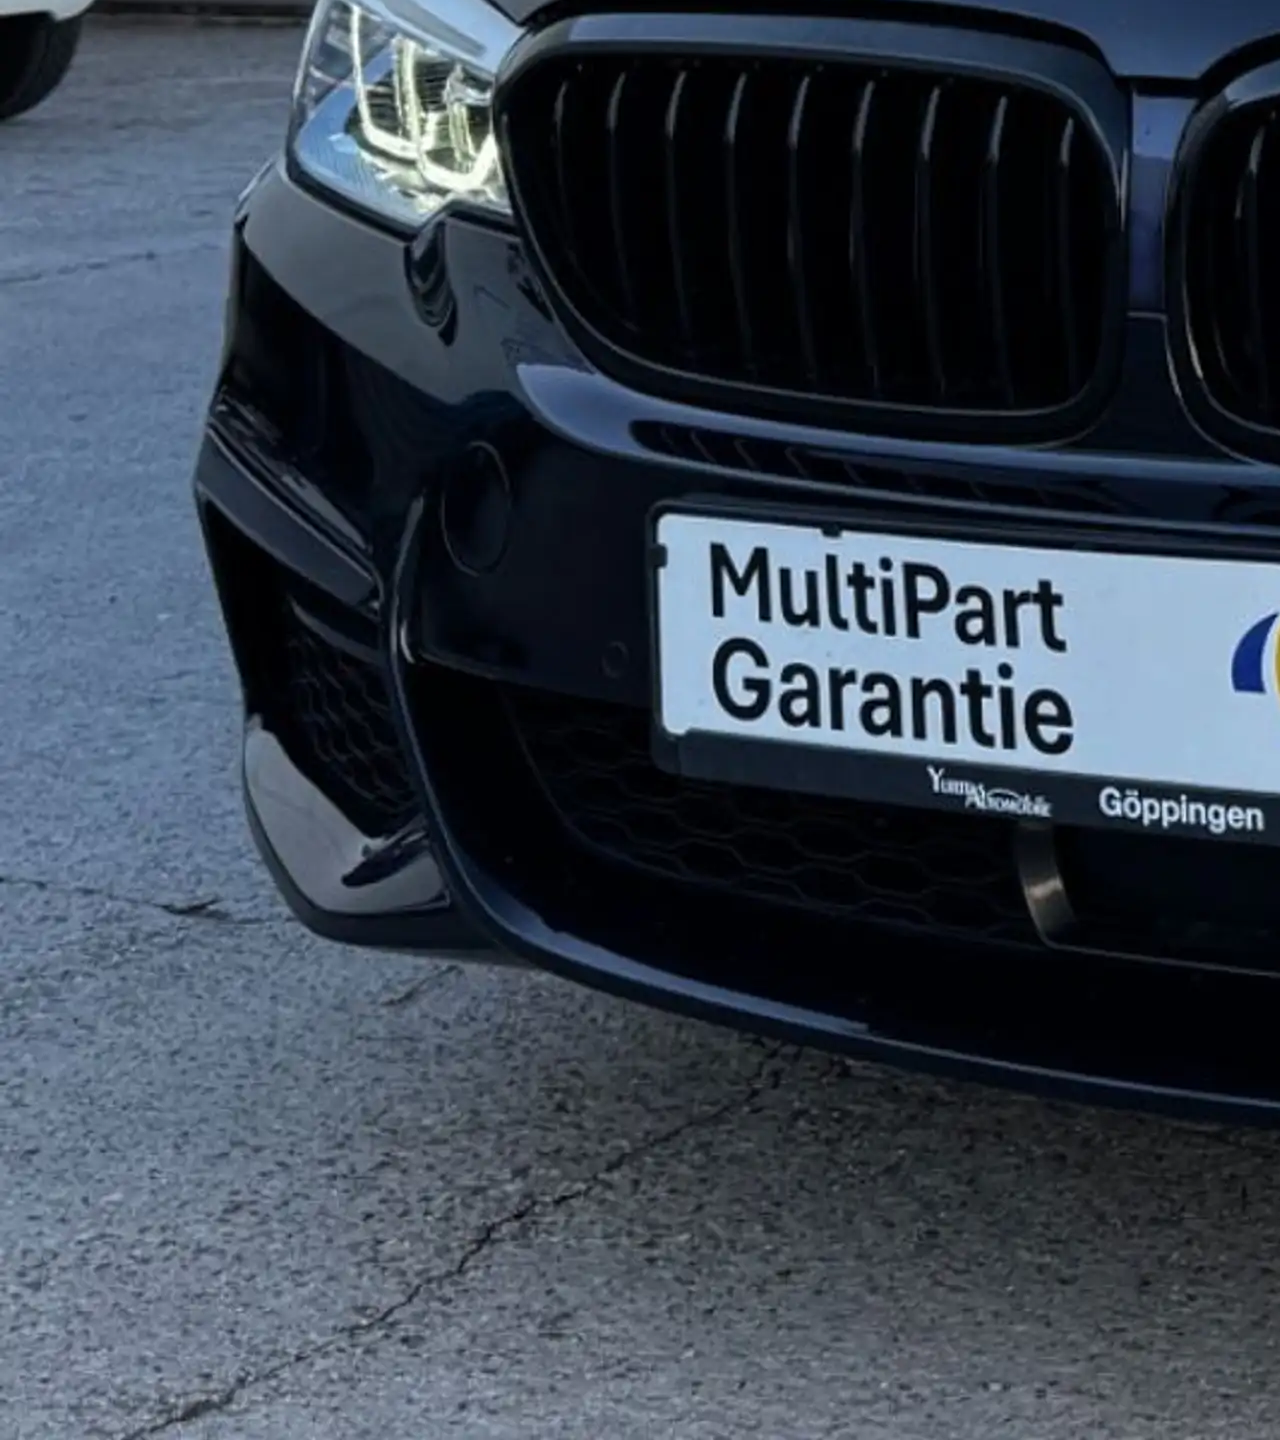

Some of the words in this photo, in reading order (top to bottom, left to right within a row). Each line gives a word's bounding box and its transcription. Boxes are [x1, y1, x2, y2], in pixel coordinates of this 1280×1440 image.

[709, 541, 1068, 653] MultiPart
[712, 636, 1074, 755] Garantie
[1099, 786, 1265, 834] Göppingen
